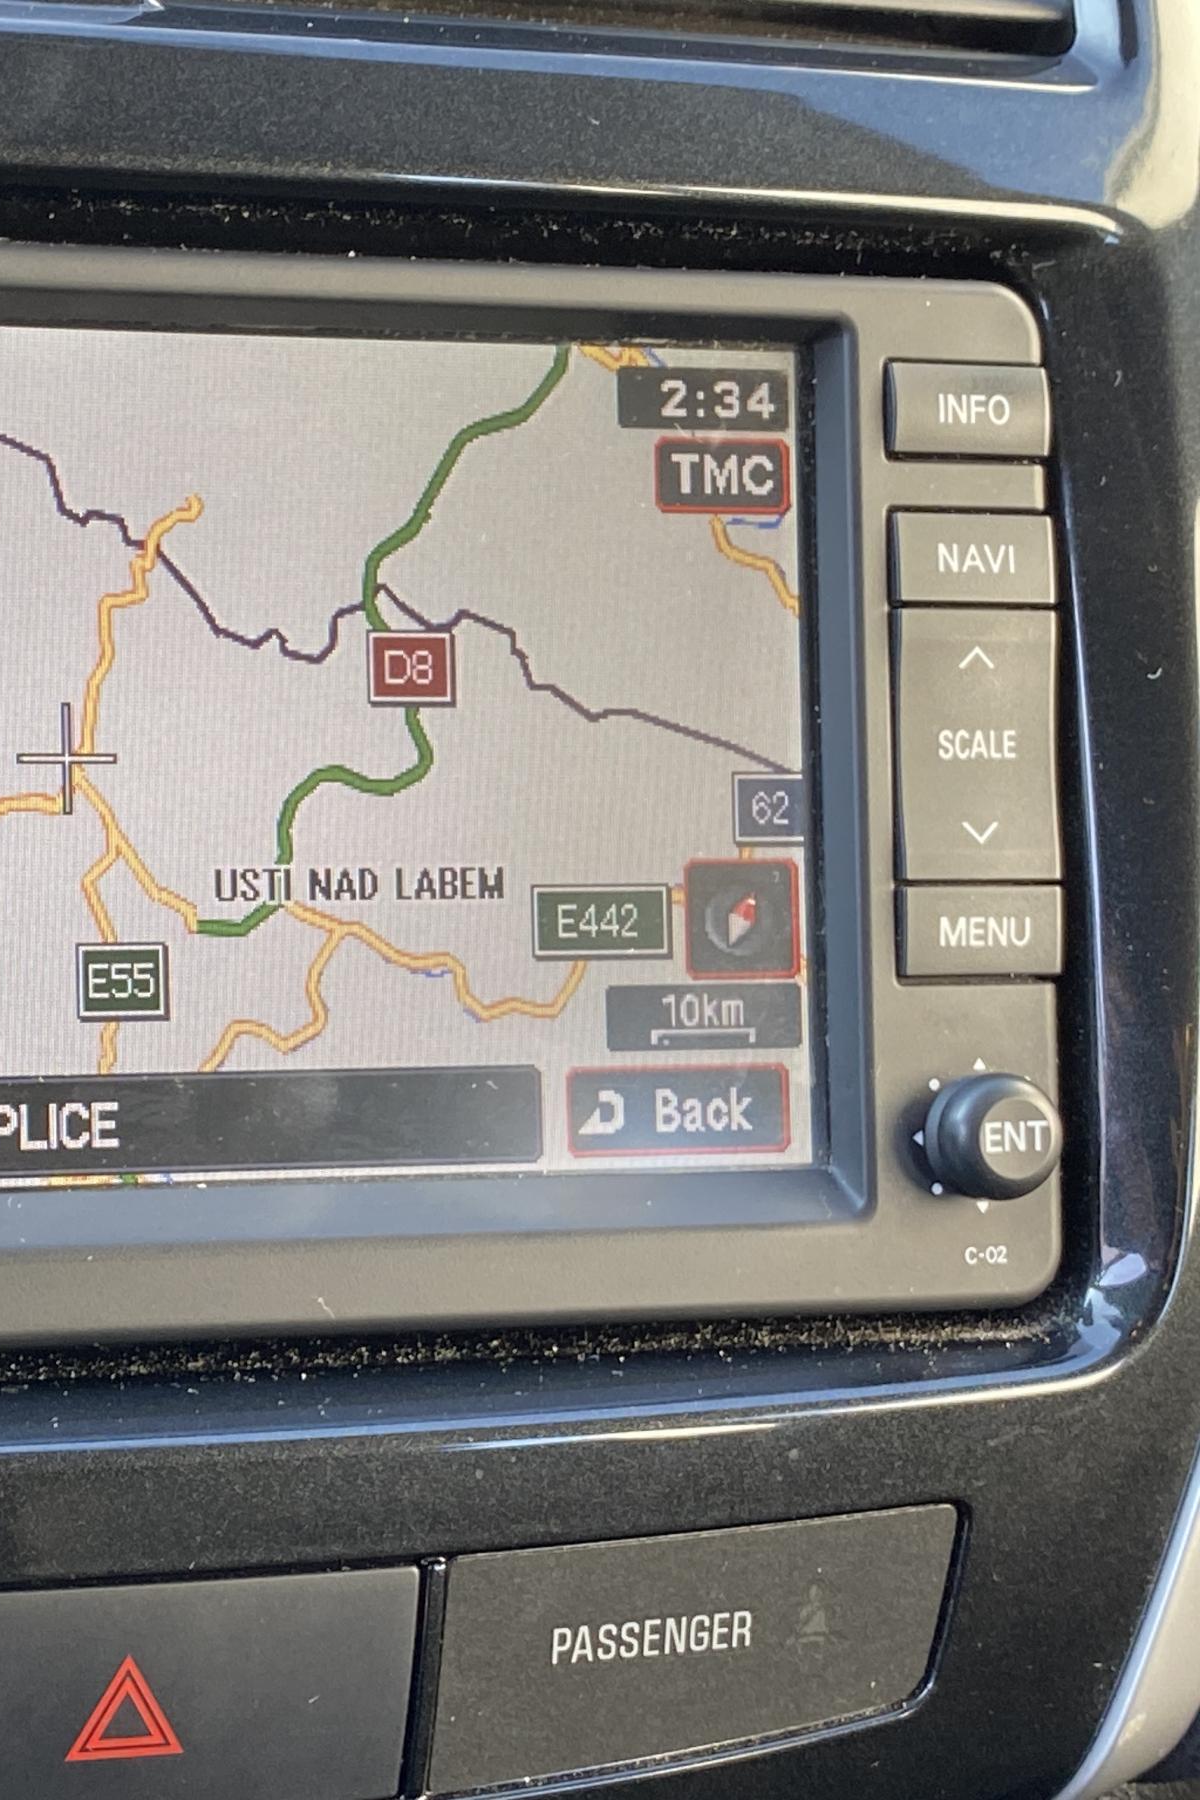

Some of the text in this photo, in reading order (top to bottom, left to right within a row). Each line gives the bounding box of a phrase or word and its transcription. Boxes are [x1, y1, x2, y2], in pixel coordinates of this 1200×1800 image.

[661, 380, 776, 419] 2:34
[938, 394, 1010, 426] INFO
[672, 454, 775, 497] TMC
[937, 544, 1016, 575] NAVI
[383, 651, 433, 685] D8
[938, 730, 1017, 760] SCALE
[751, 791, 789, 826] 62
[214, 866, 504, 901] USTI NAD LABEM
[557, 904, 638, 939] E442
[940, 917, 1031, 947] MENU
[87, 962, 155, 998] E55
[662, 994, 744, 1027] 10km
[655, 1088, 753, 1133] Back
[984, 1119, 1048, 1153] ENT
[551, 1610, 752, 1665] PASSENGER
